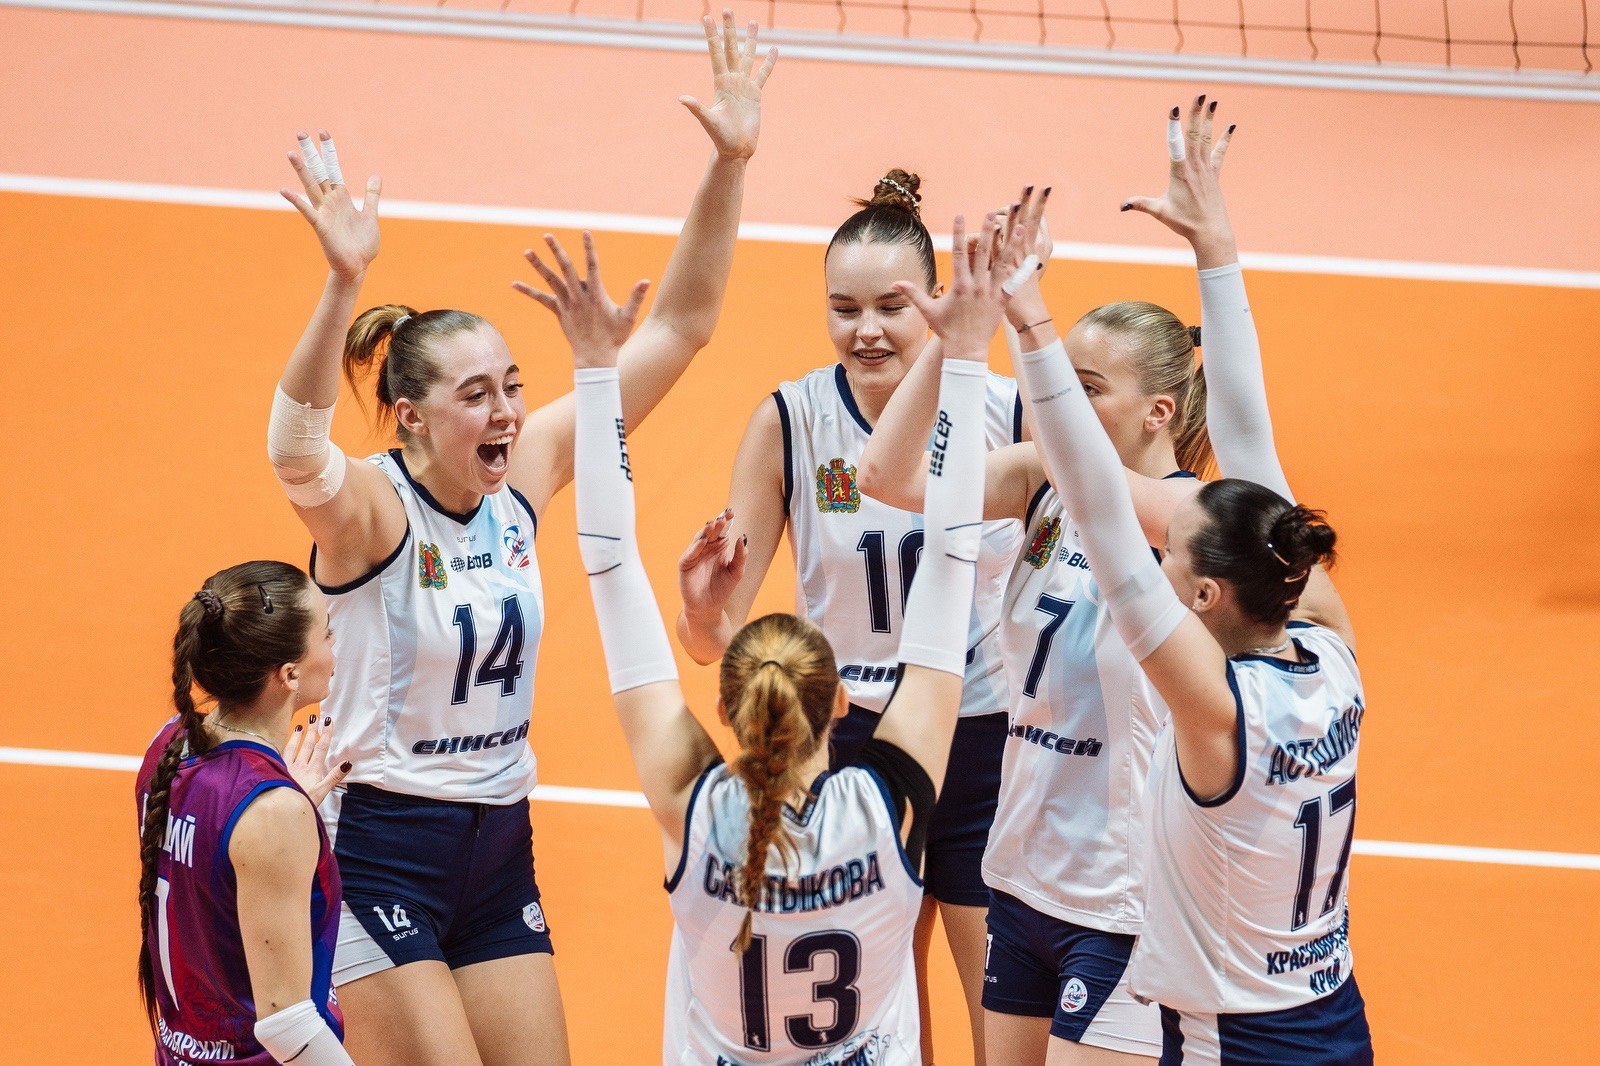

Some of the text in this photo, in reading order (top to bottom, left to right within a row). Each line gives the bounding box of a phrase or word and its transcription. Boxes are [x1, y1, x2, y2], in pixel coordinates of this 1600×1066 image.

[451, 594, 526, 705] 14
[1023, 592, 1076, 699] 7
[411, 719, 530, 754] ЕНИСЕЙ
[1009, 724, 1103, 757] НИСЕЙ
[703, 851, 886, 914] САТЫКОВА
[1290, 776, 1357, 932] 17
[373, 904, 412, 932] 14
[392, 928, 419, 941] surus
[729, 929, 862, 1052] 13
